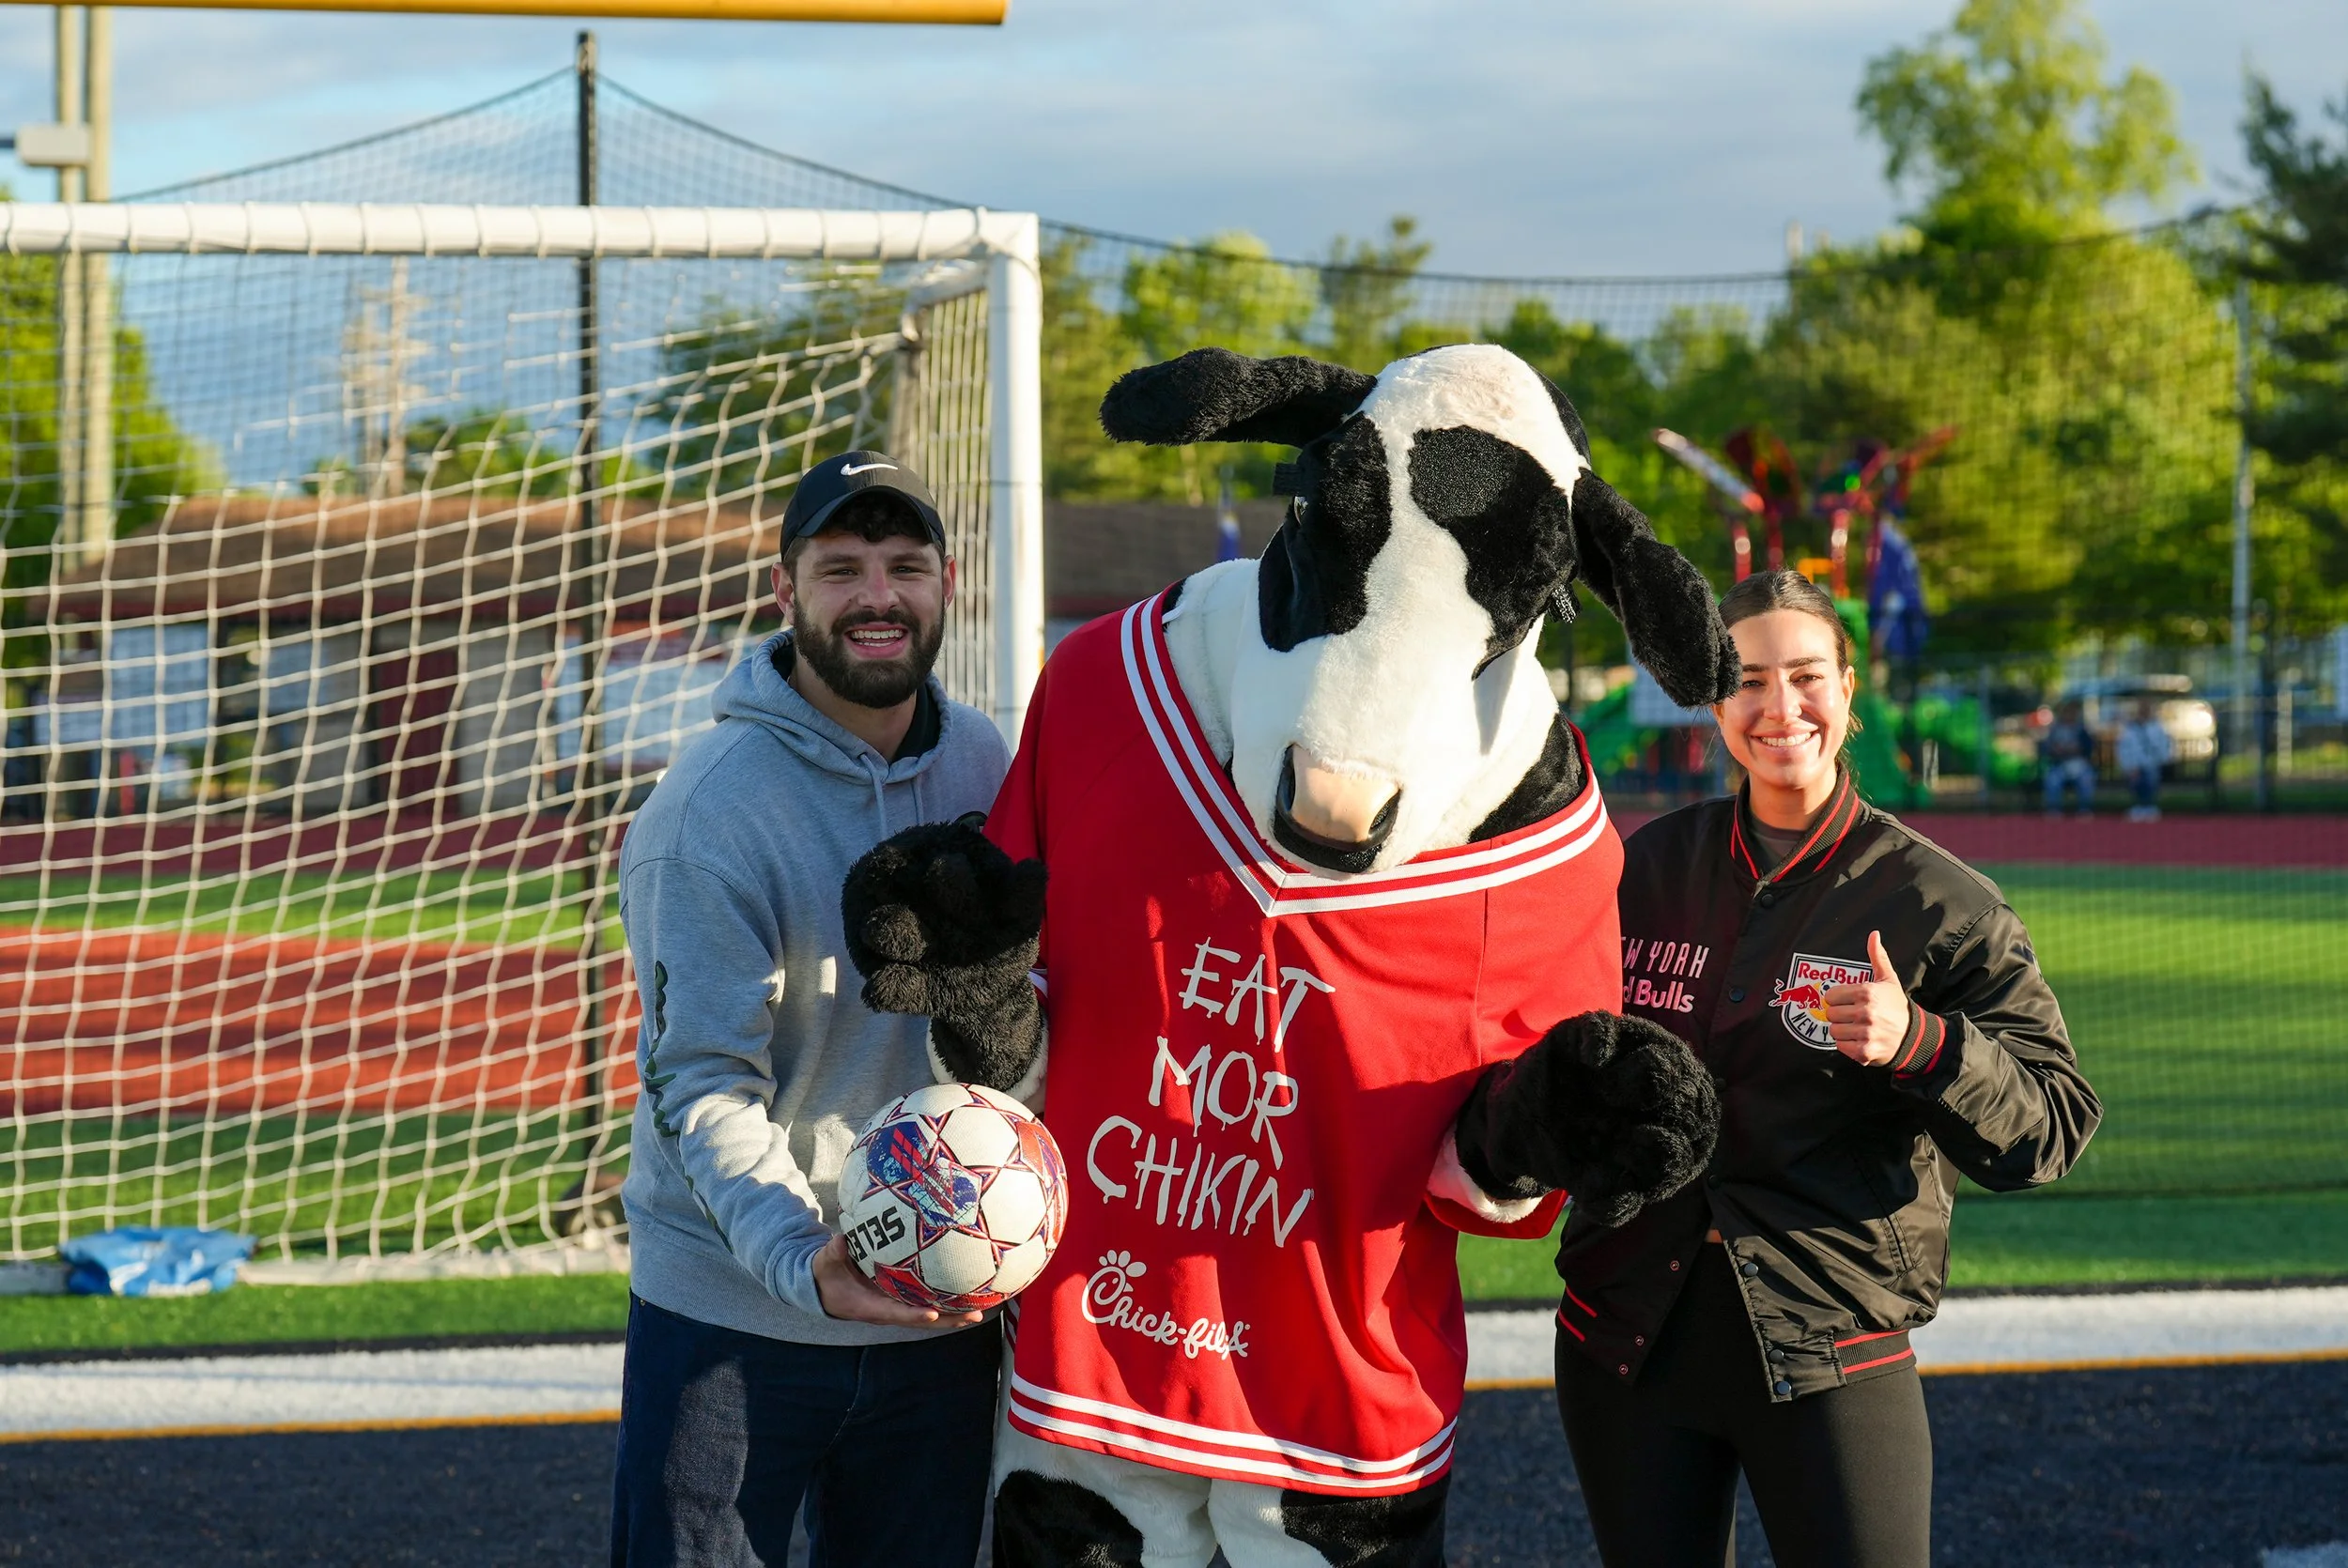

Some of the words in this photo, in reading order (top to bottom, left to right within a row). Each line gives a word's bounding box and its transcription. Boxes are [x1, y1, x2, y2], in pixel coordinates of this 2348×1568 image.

[1179, 937, 1336, 1053] EAT
[1633, 979, 1695, 1013] Bulls
[1798, 962, 1833, 981] Red
[1791, 1011, 1818, 1038] NEW
[1149, 1036, 1300, 1170] MOR
[1087, 1115, 1312, 1248] CHIKIN
